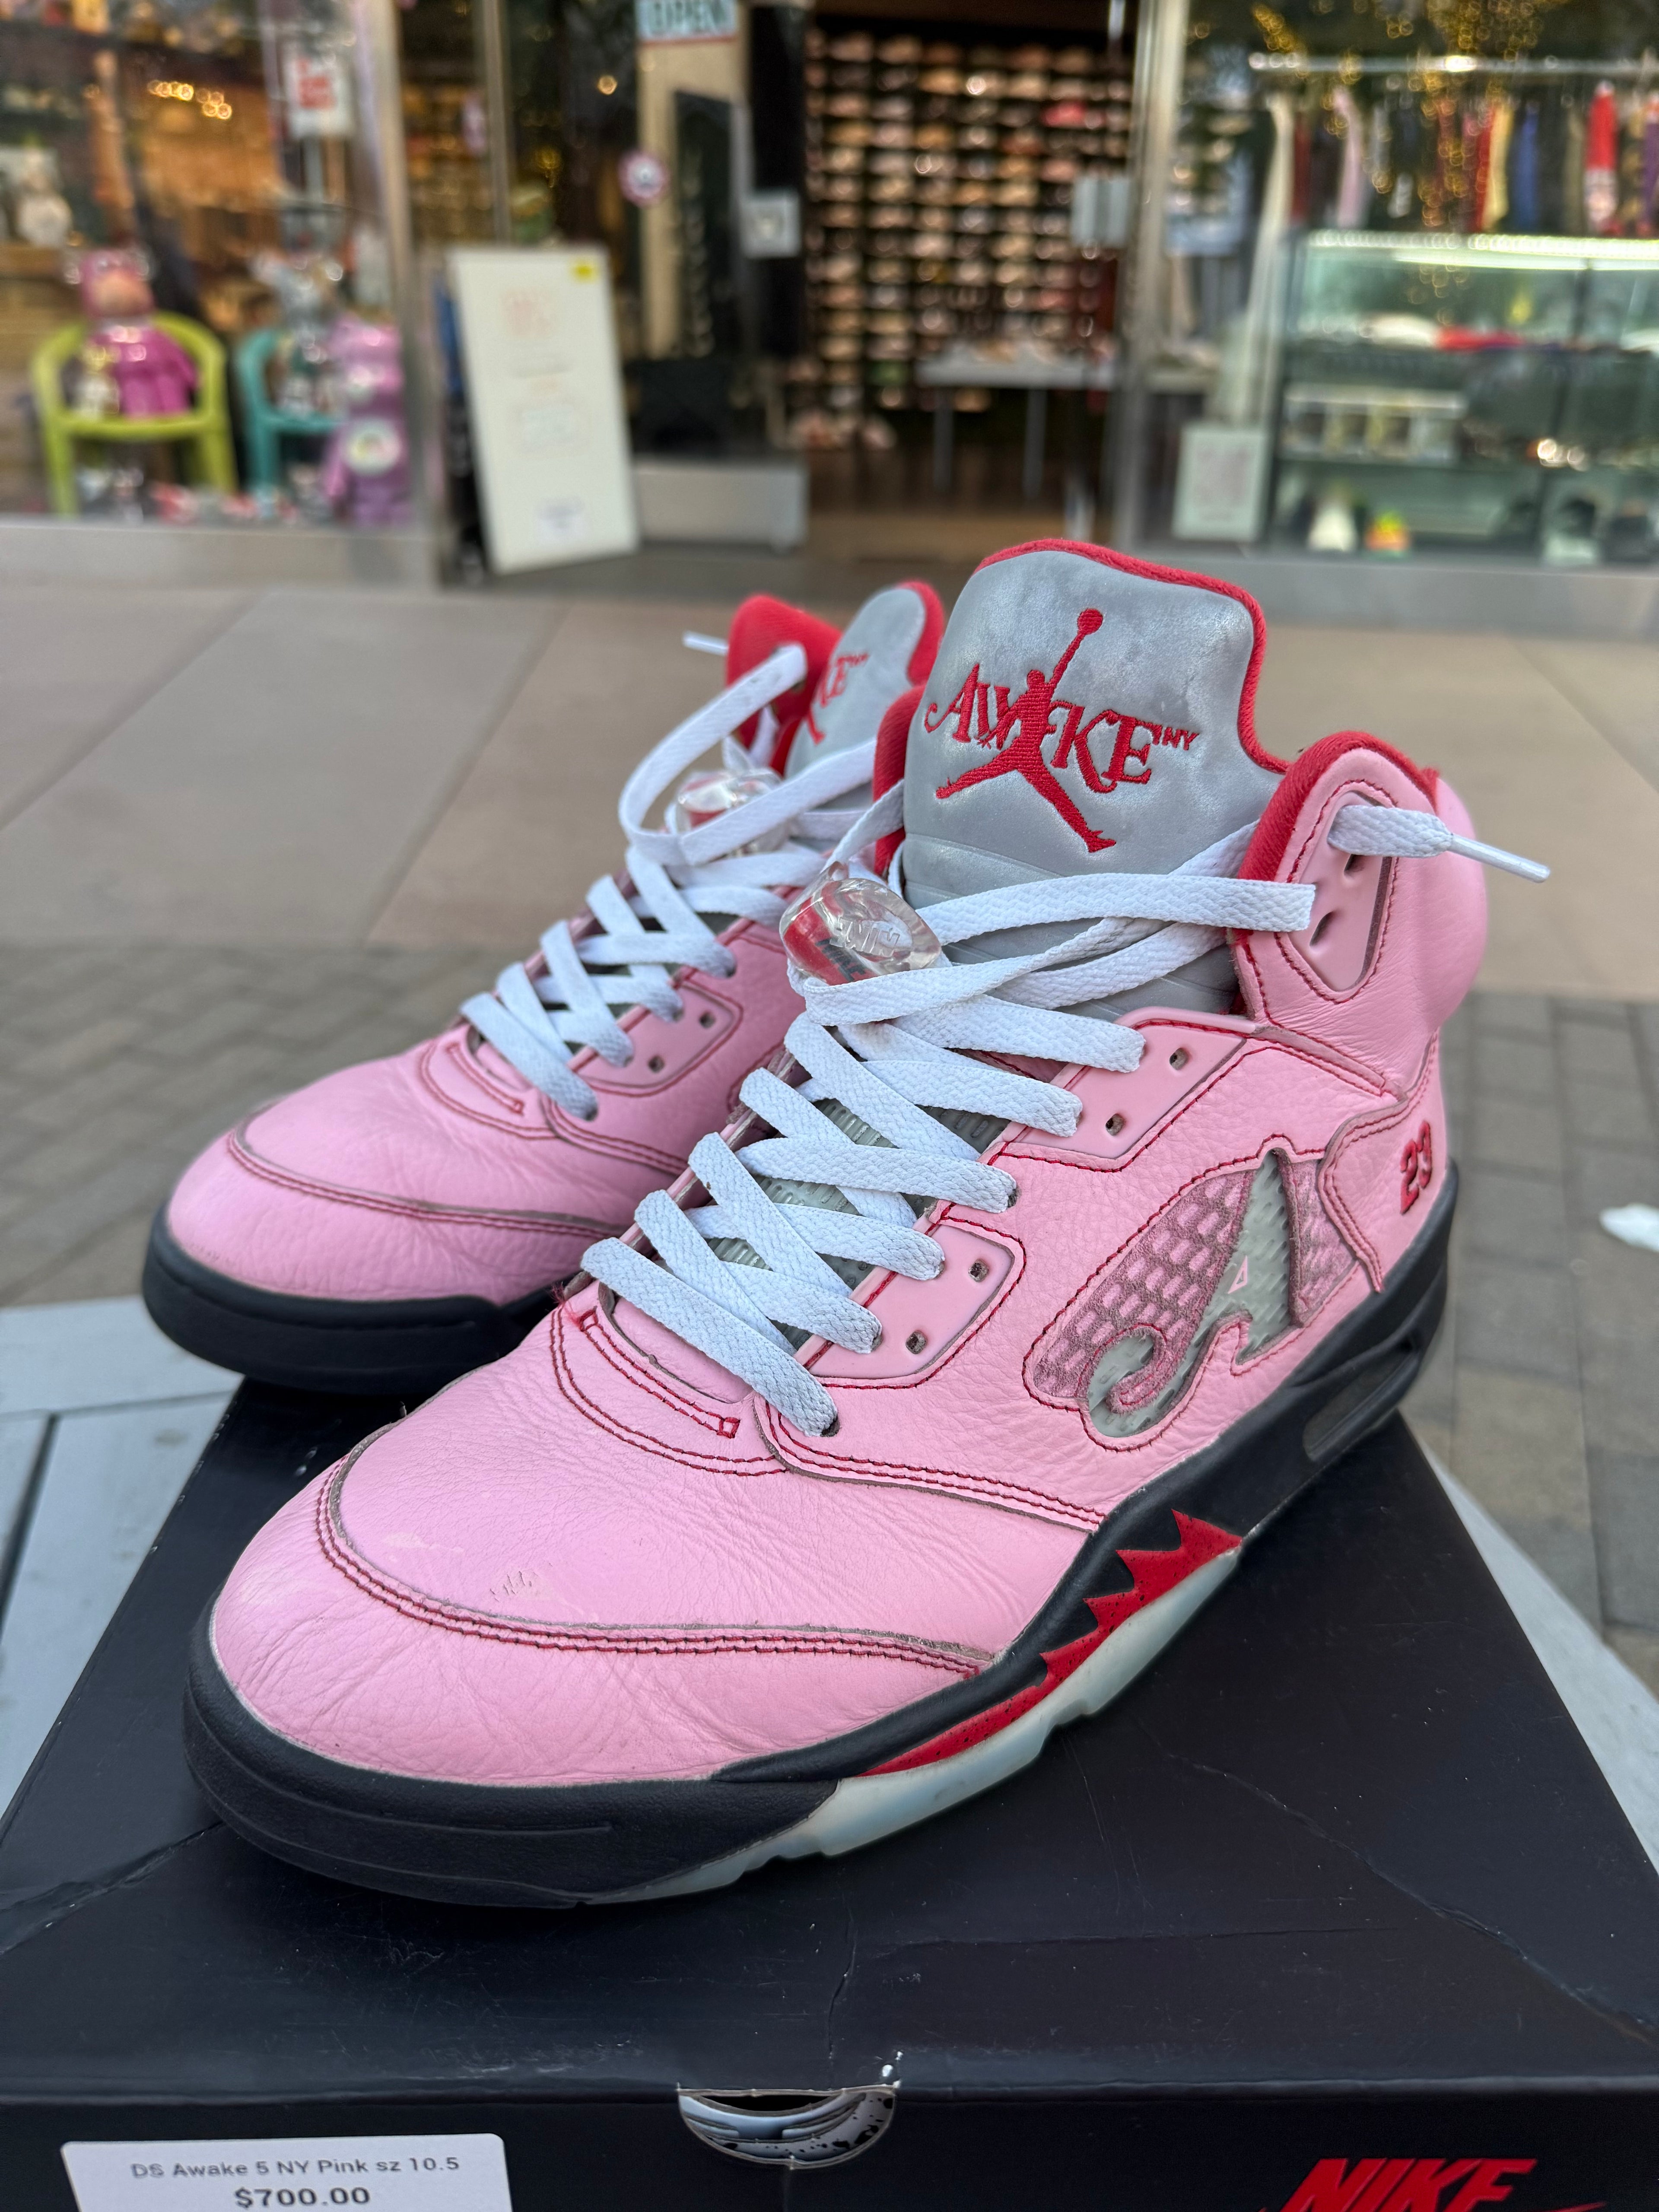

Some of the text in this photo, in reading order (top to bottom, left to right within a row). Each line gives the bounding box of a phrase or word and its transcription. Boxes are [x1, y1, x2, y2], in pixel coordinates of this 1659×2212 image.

[924, 663, 1163, 793] AWKE
[1399, 1121, 1432, 1215] 23
[131, 2157, 459, 2179] DS Awake 5 NY Pink sz 10.5
[1279, 2158, 1537, 2212] NIKE
[234, 2186, 370, 2209] $700.00
